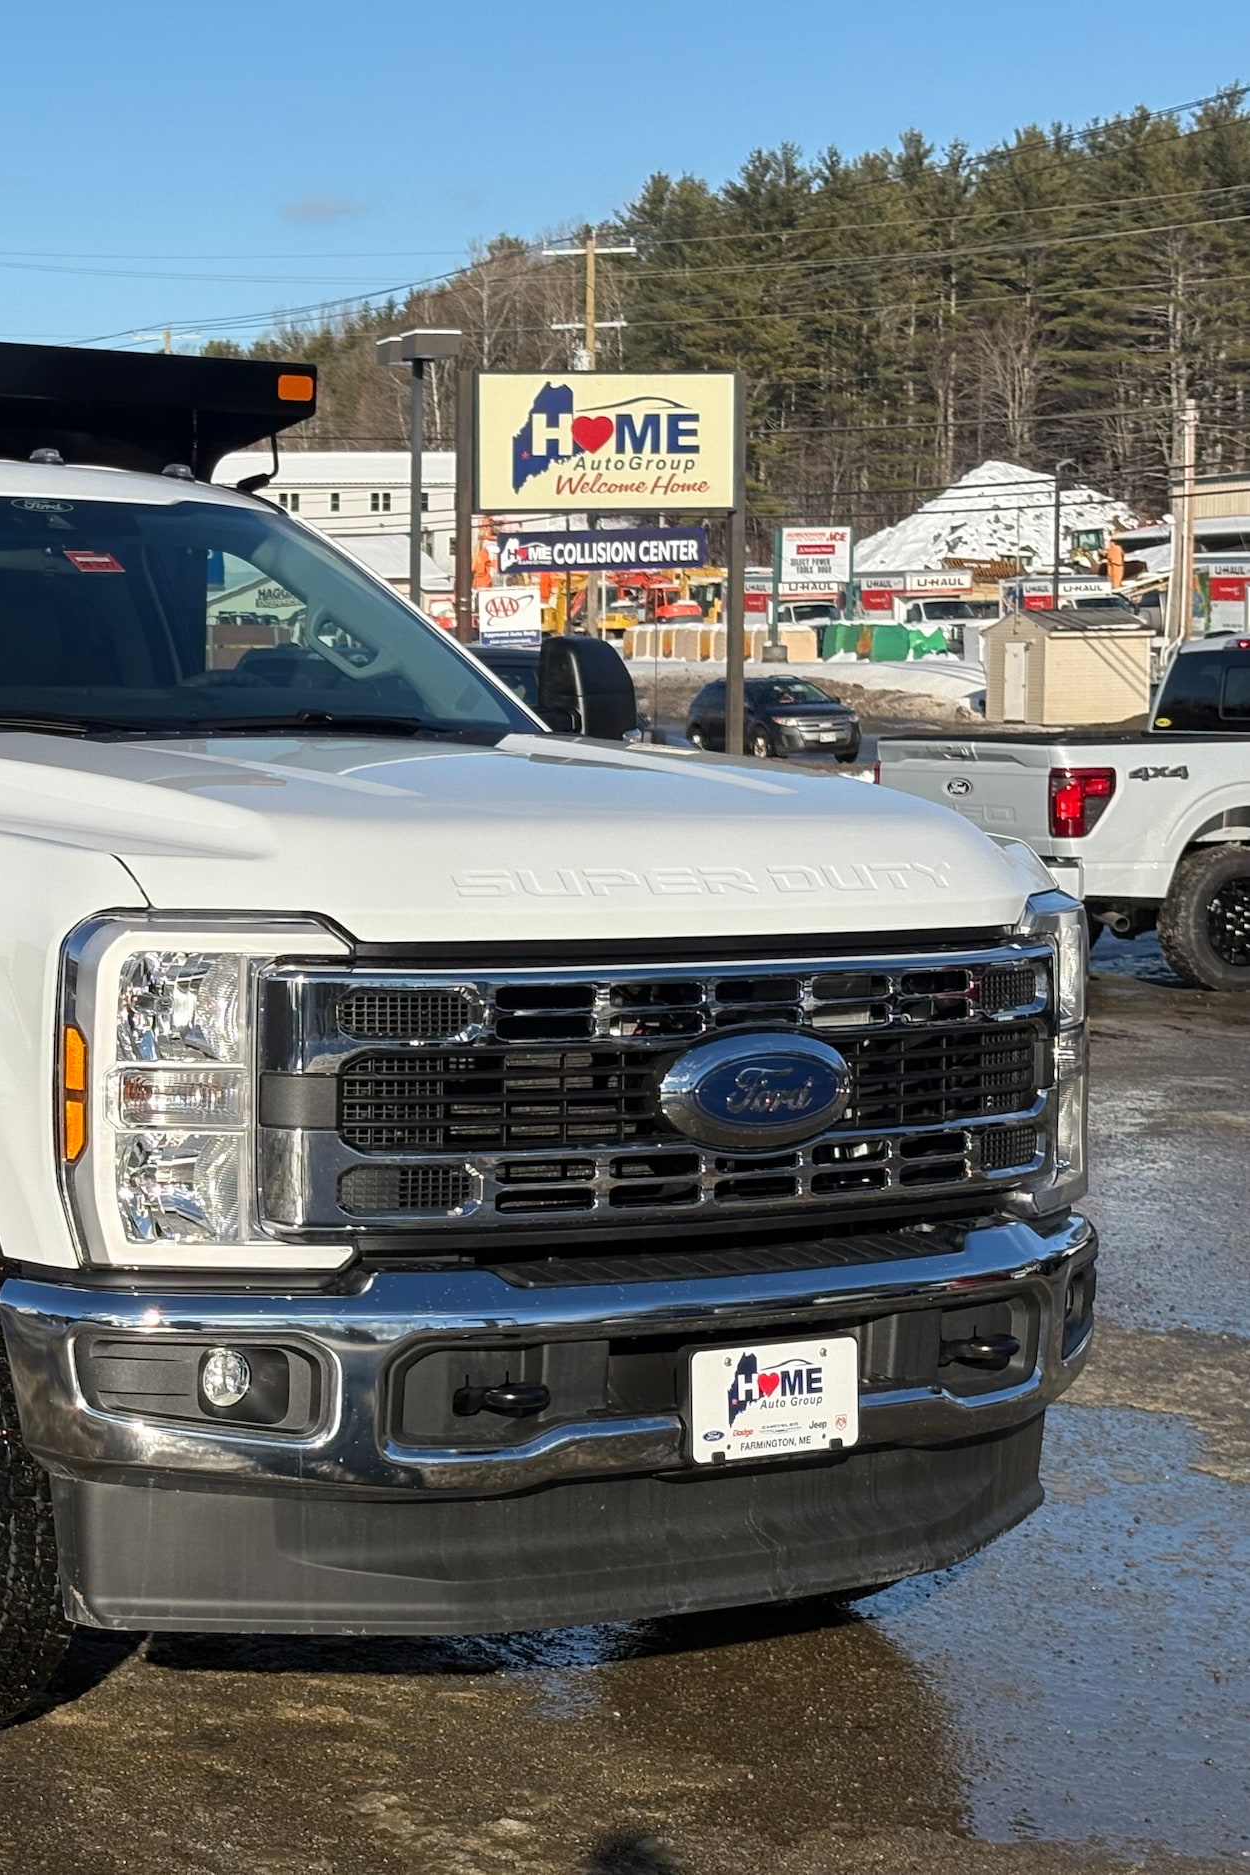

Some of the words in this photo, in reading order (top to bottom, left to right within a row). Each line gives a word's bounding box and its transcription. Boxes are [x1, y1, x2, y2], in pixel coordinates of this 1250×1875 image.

[556, 473, 648, 495] Welcome
[650, 473, 710, 495] Home
[553, 541, 637, 565] COLLISION
[639, 539, 699, 562] CENTER
[451, 867, 759, 897] SUPER
[766, 861, 950, 893] DUTY
[726, 1066, 814, 1115] Ford
[760, 1399, 786, 1410] Auto
[791, 1395, 823, 1407] Group
[732, 1428, 754, 1437] Dodge
[808, 1420, 827, 1430] Jeep
[799, 1435, 812, 1445] ME
